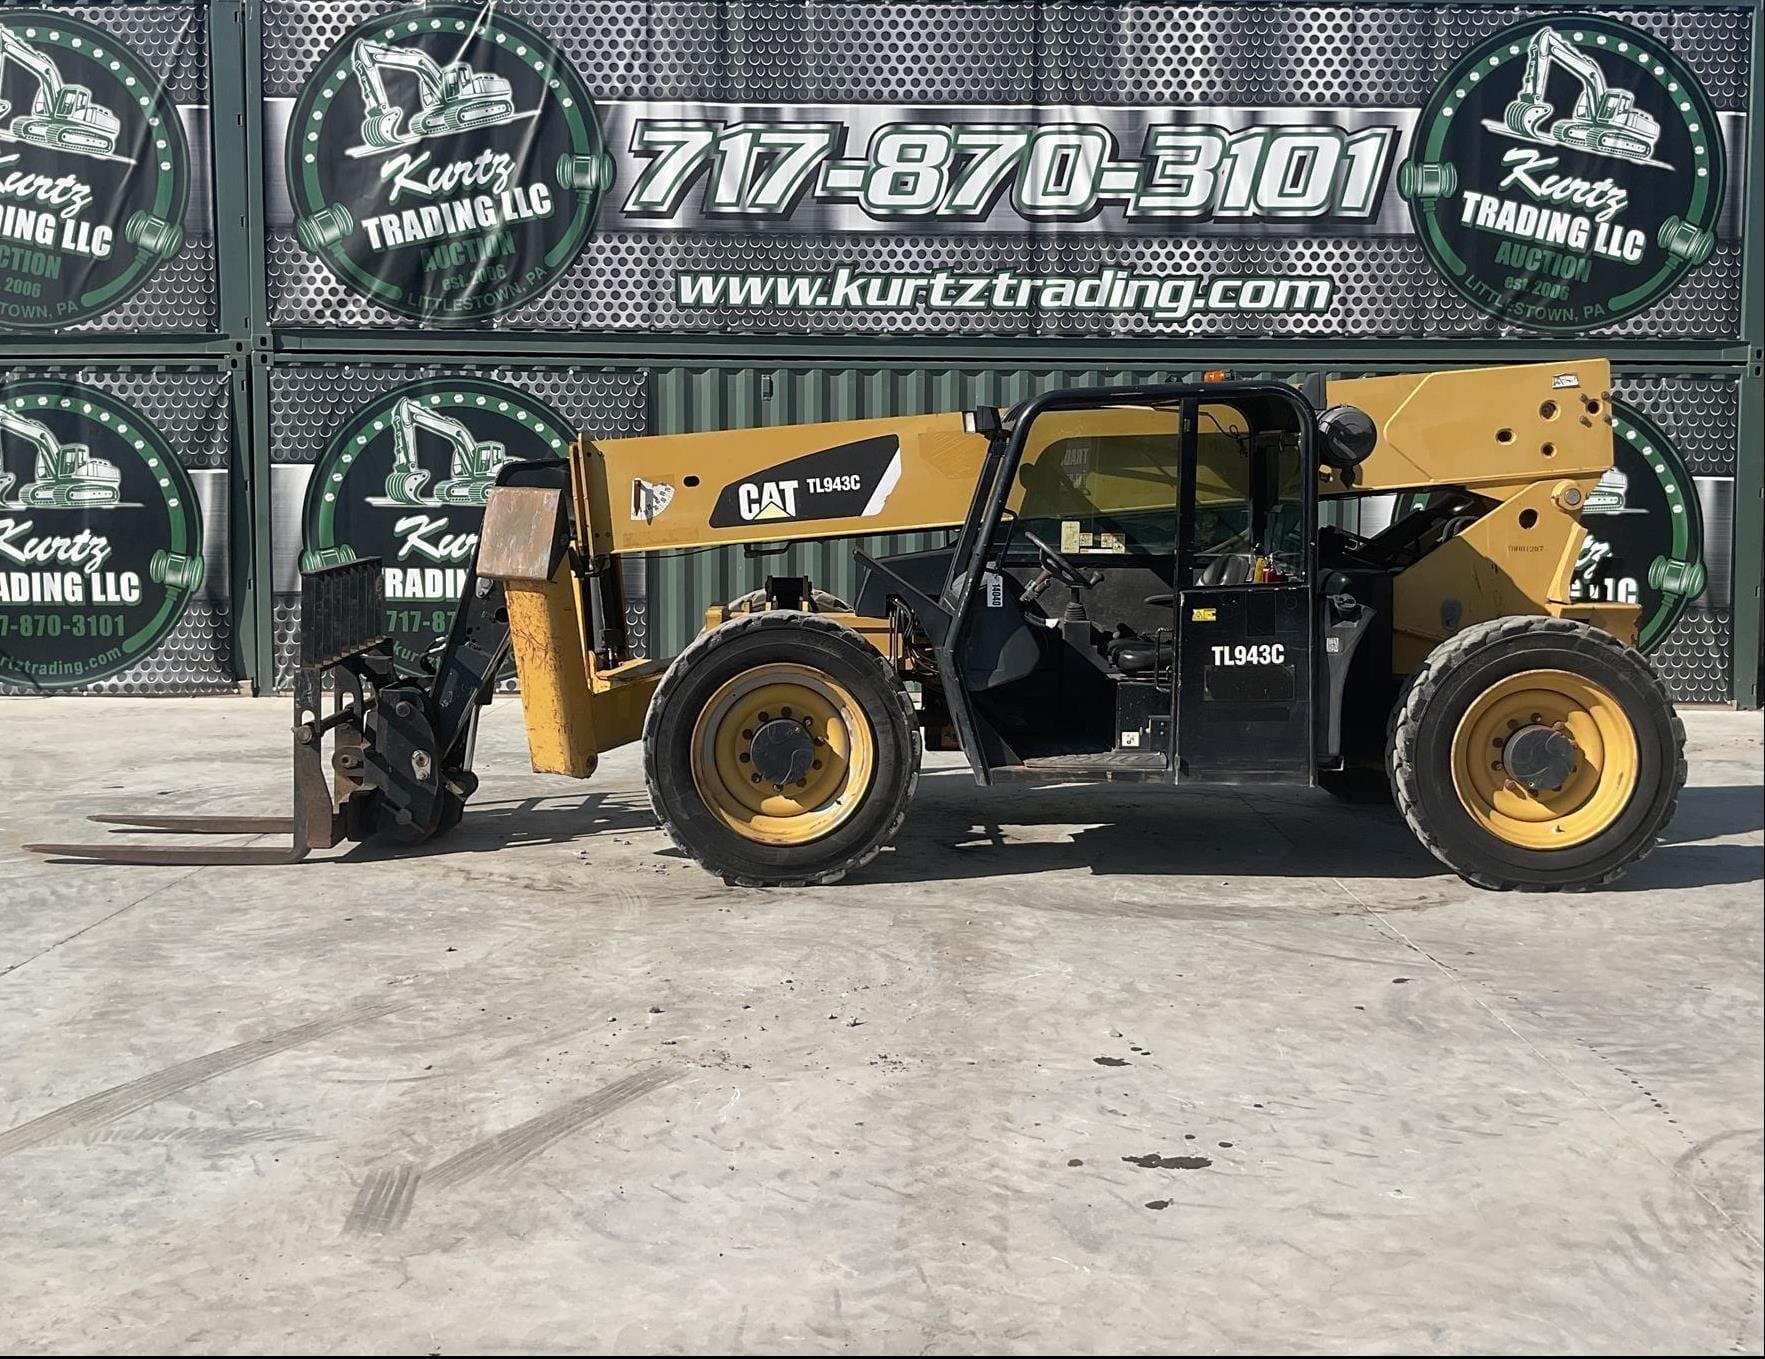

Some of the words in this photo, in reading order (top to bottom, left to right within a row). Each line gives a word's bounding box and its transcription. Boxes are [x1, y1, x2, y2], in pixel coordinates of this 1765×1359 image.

[0, 153, 93, 219] urtz
[381, 148, 514, 201] Kurtz
[620, 119, 1400, 223] 717-870-3101
[1500, 148, 1628, 221] Kurtz
[362, 194, 498, 250] TRADING
[501, 182, 552, 222] LLC
[1461, 190, 1590, 250] TRADING
[1595, 222, 1647, 263] LLC
[61, 218, 113, 257] LLC
[422, 231, 517, 272] AUCTION
[529, 266, 548, 285] PA
[1494, 241, 1593, 283] AUCTION
[5, 277, 42, 299] 2006
[677, 272, 1333, 320] www.kurtztrading.com
[1532, 280, 1571, 302] 2006
[57, 302, 79, 316] PA
[1583, 303, 1606, 319] PA
[738, 479, 799, 521] CAT
[806, 475, 861, 495] TL943C
[0, 518, 112, 575] Kurtz
[91, 571, 141, 603] LLC
[991, 584, 1001, 606] 14040
[1211, 644, 1286, 667] TL943C
